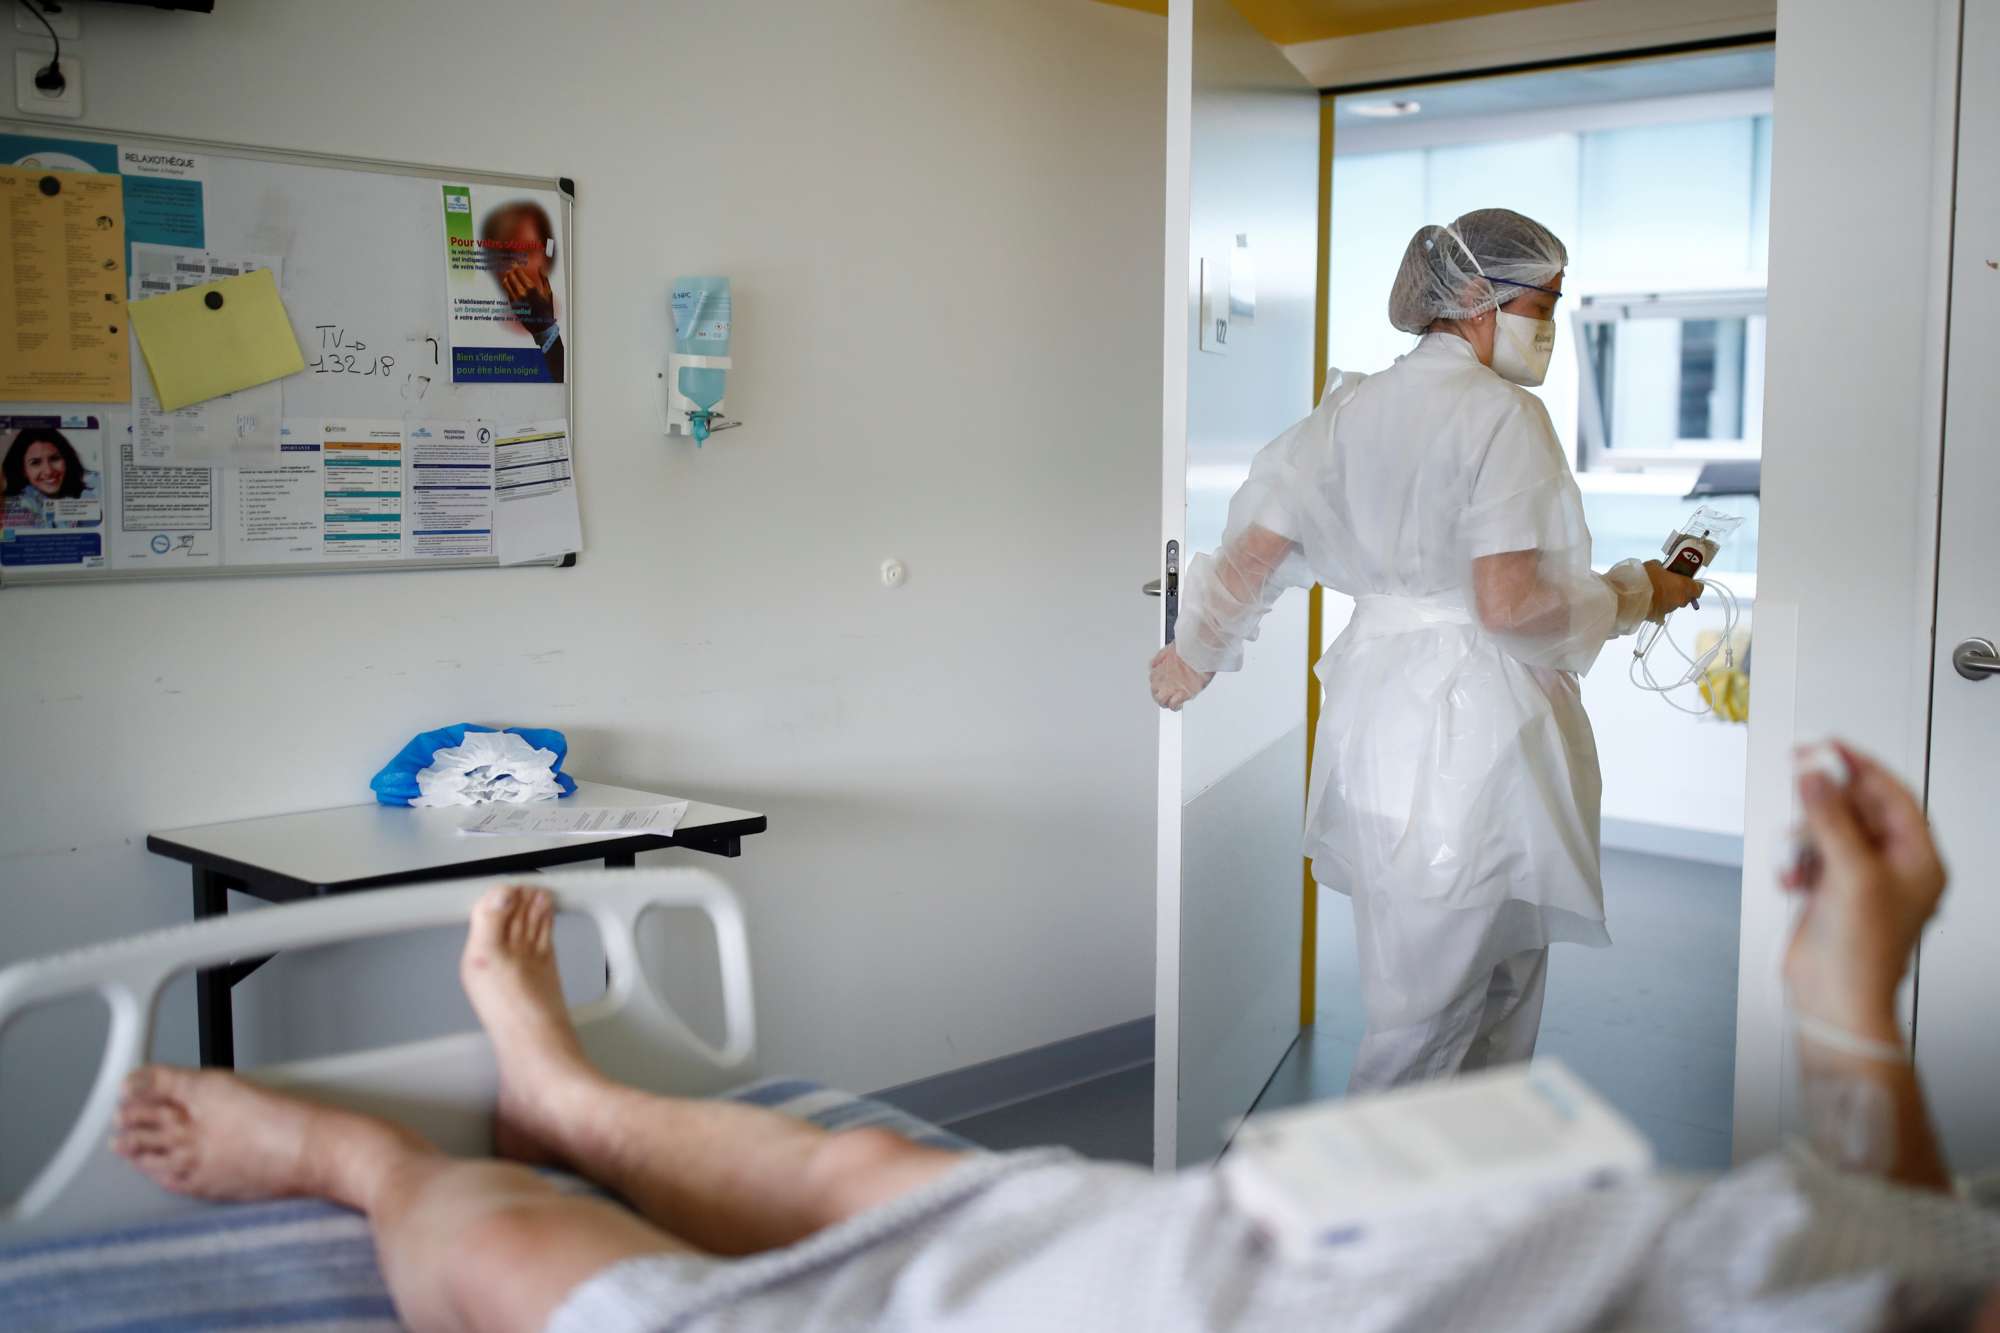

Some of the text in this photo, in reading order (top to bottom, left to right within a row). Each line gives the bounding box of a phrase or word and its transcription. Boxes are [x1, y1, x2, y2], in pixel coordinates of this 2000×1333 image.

[450, 236, 474, 248] Pour
[316, 325, 344, 348] TV
[456, 352, 514, 361] Bien s'identifier
[456, 365, 539, 376] pour être bien soigné
